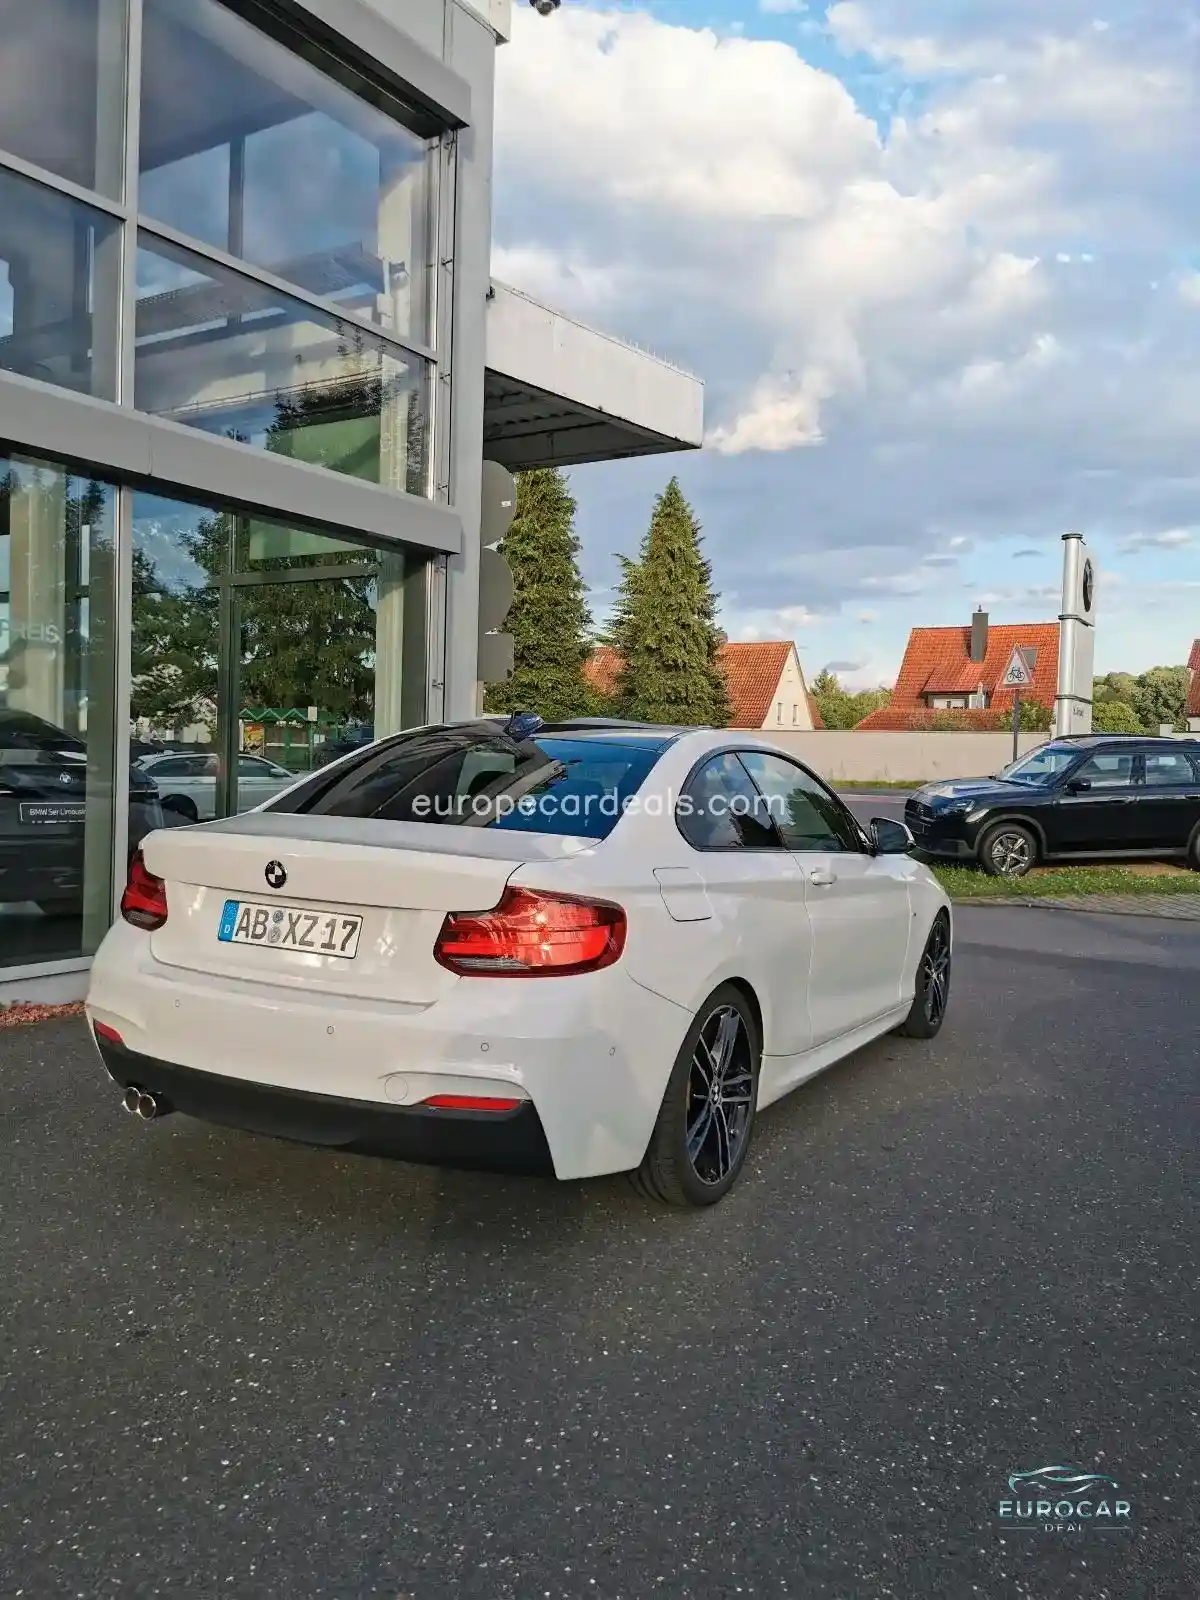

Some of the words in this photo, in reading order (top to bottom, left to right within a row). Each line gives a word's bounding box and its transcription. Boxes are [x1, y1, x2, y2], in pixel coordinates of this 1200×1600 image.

[29, 808, 47, 816] BMW
[224, 925, 230, 934] D
[235, 907, 270, 940] AB
[282, 912, 320, 947] XZ
[320, 918, 359, 952] 17
